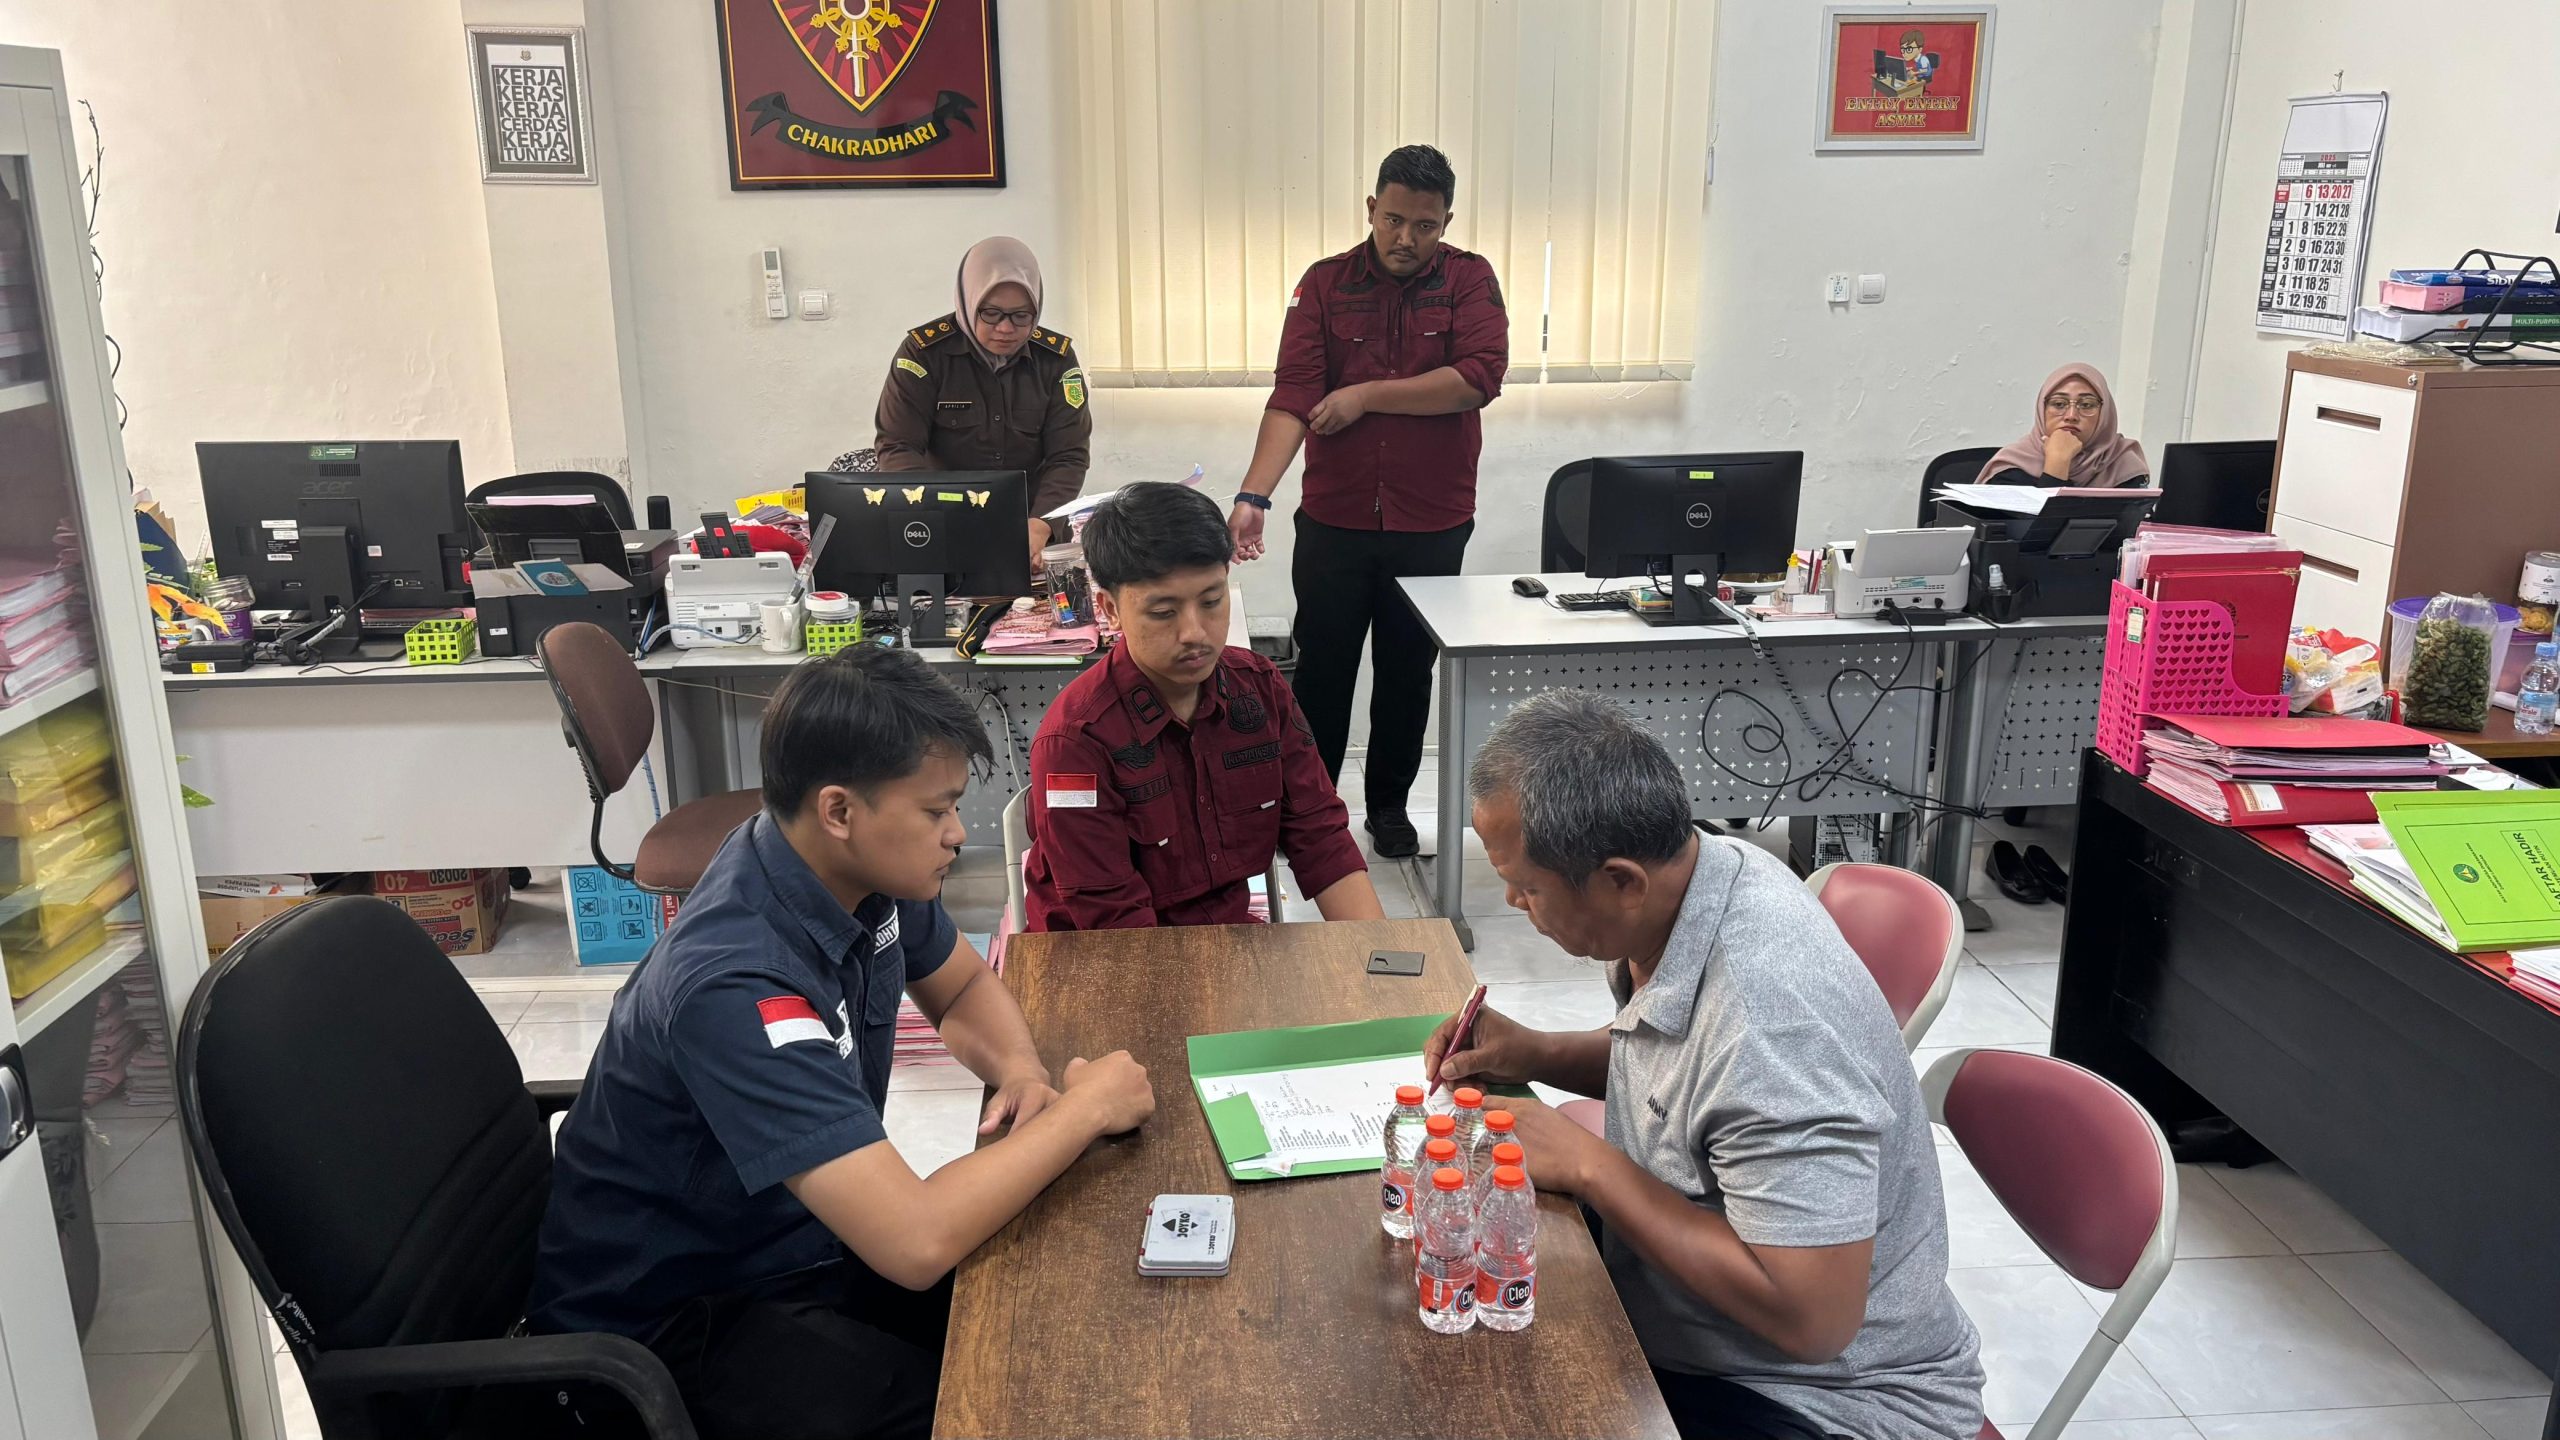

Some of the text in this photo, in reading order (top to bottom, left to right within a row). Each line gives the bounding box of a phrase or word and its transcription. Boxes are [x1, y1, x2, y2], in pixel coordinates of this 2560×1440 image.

[495, 68, 562, 86] KERJA
[497, 85, 564, 102] KERAS
[499, 101, 566, 118] KERJA
[1845, 96, 1960, 111] ENTRY ENTRY
[501, 118, 567, 132] CERDAS
[502, 131, 569, 148] KERJA
[787, 122, 938, 156] CHAKRADHARI
[504, 147, 570, 162] TUNTAS
[2306, 185, 2352, 198] 6 13 20 27
[2304, 203, 2350, 218] 7 14 21 28
[2288, 221, 2294, 235] 1
[2302, 221, 2309, 235] 8
[2313, 221, 2325, 235] 15
[2326, 222, 2337, 236] 22
[2338, 222, 2347, 237] 29
[2285, 239, 2292, 252] 2
[2299, 239, 2306, 253] 9
[2311, 240, 2322, 254] 16
[2324, 241, 2335, 255] 23
[2335, 241, 2345, 255] 30
[2282, 257, 2289, 270] 3
[2294, 257, 2306, 271] 10
[2308, 258, 2319, 272] 17
[2321, 259, 2332, 273] 24
[2333, 260, 2342, 274] 31
[2280, 275, 2286, 288] 4
[2292, 275, 2303, 289] 11
[2305, 276, 2316, 290] 18
[2318, 277, 2329, 291] 25
[2277, 292, 2284, 305] 5
[2289, 293, 2300, 307] 12
[2303, 294, 2314, 308] 19
[2315, 295, 2327, 309] 26
[303, 481, 353, 495] acer
[429, 868, 468, 885] 20030
[2513, 832, 2560, 905] AFTAR HADIR
[383, 873, 409, 891] 40
[1384, 1188, 1401, 1206] Cleo
[1177, 1212, 1191, 1238] JOYKO
[1462, 1288, 1475, 1305] Cle
[1508, 1285, 1530, 1302] Cleo
